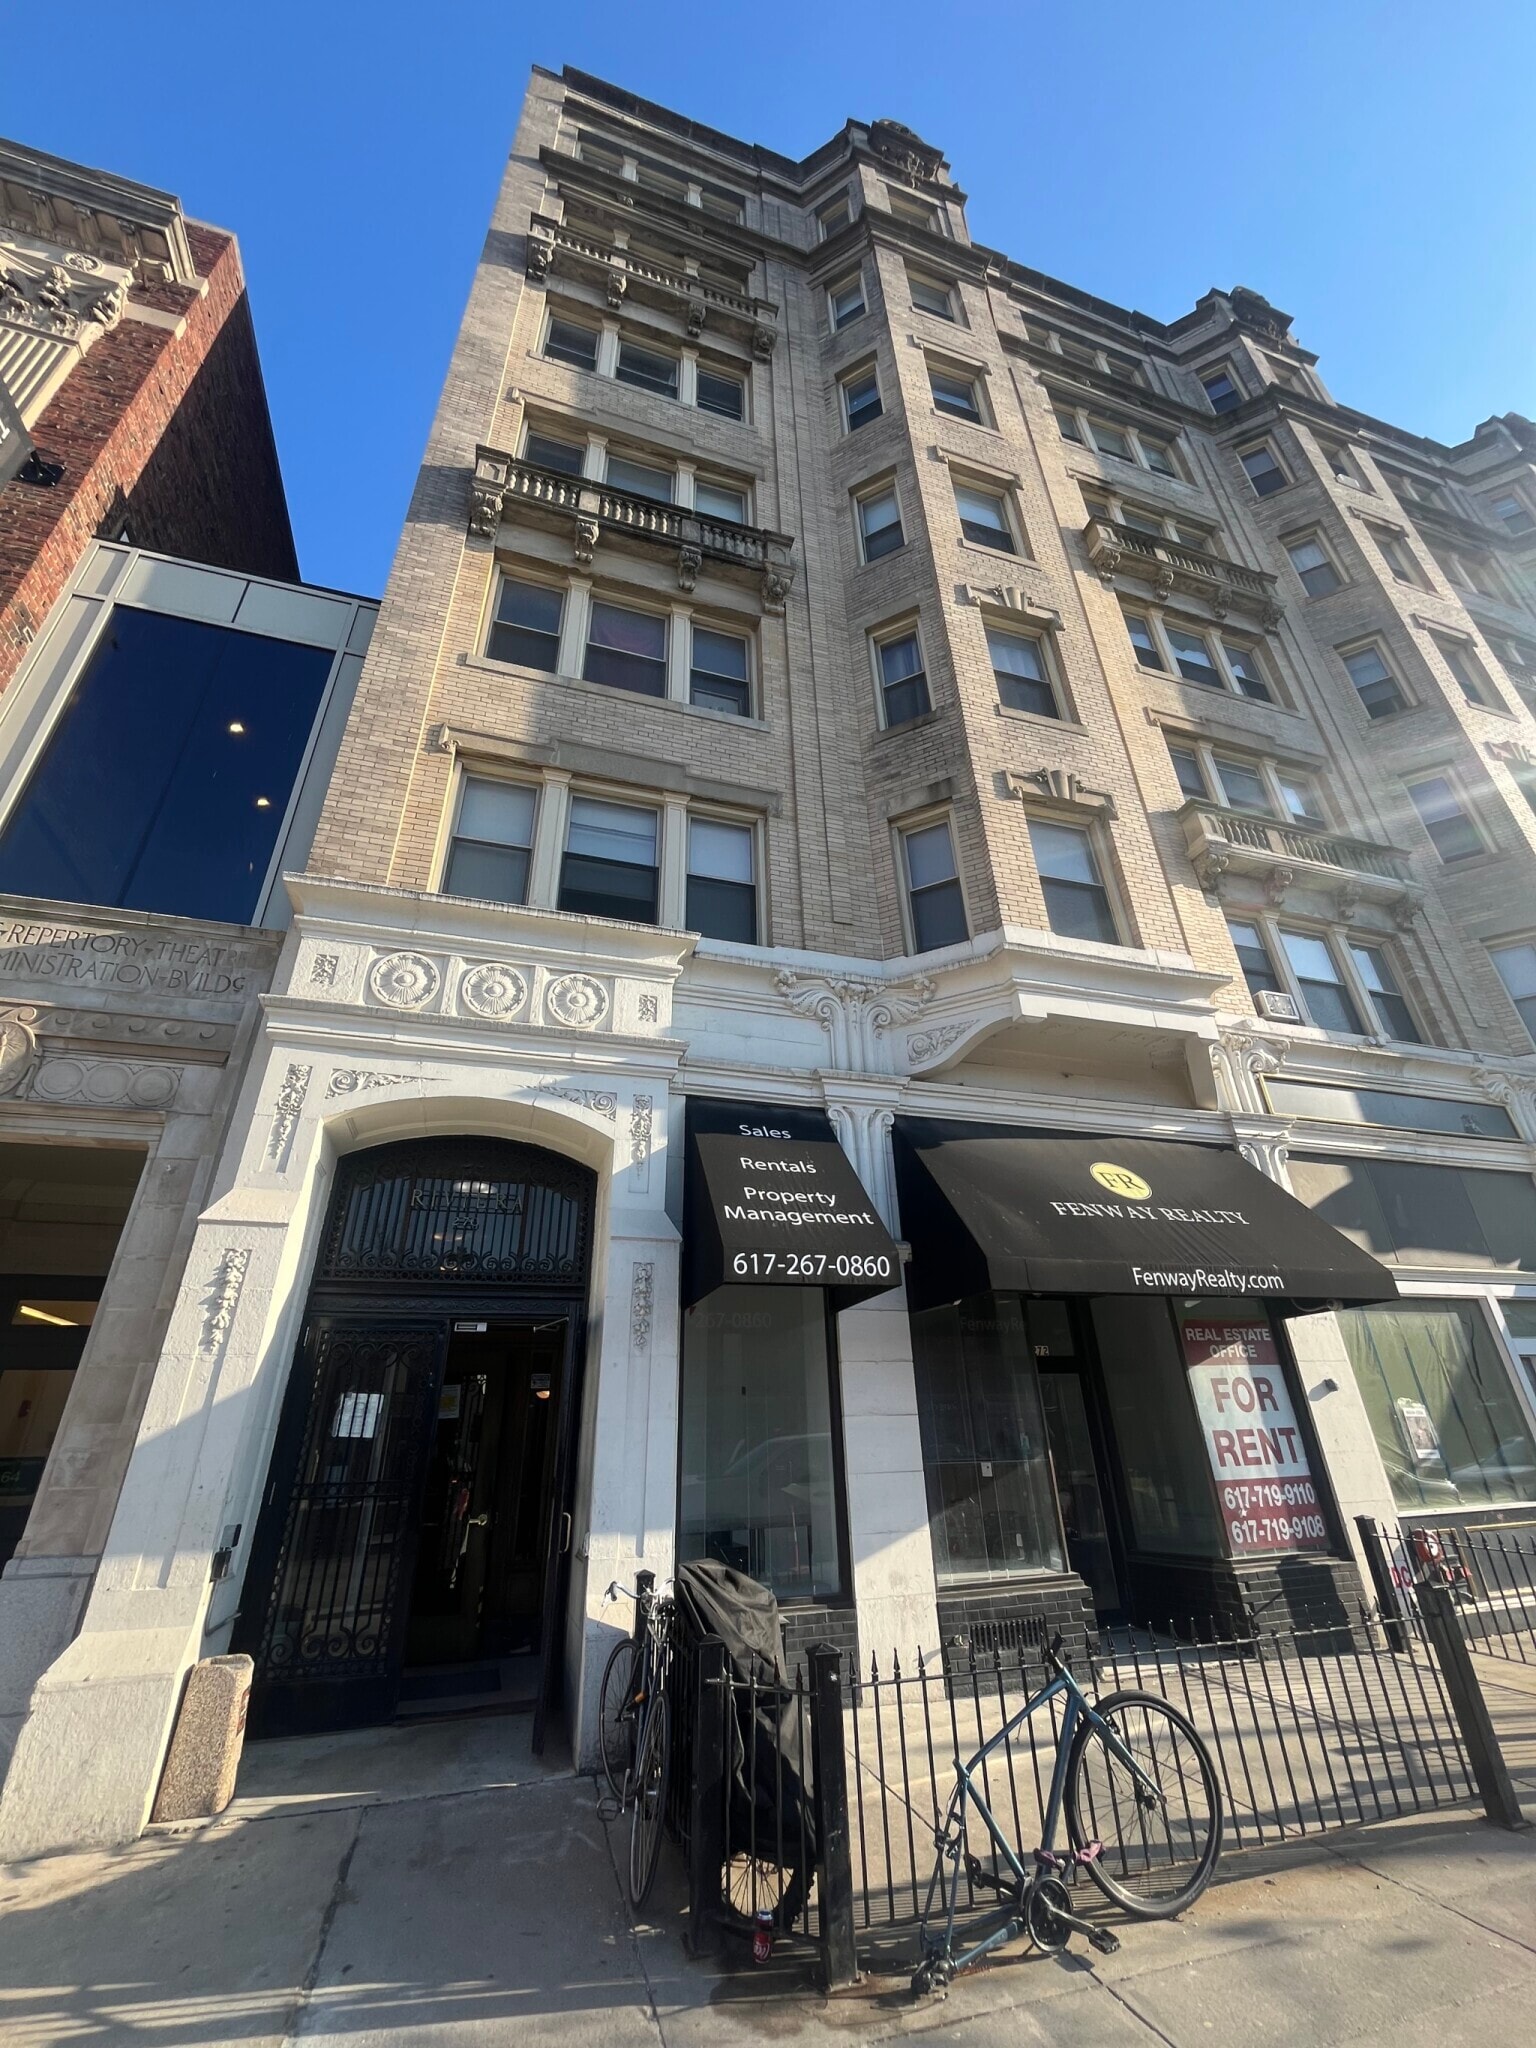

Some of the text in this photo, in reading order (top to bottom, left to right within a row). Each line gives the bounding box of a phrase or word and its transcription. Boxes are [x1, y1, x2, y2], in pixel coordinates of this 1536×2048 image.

[6, 923, 147, 958] REPERTORY
[738, 1124, 792, 1140] Sales
[739, 1156, 817, 1174] Rentals
[1099, 1171, 1145, 1190] FR
[410, 1188, 523, 1213] RIVIERA
[743, 1186, 836, 1206] Property
[723, 1204, 875, 1226] Management
[1050, 1201, 1250, 1225] FENWAY REALTY
[732, 1252, 891, 1278] 617-267-0860
[1132, 1267, 1285, 1293] FenwayRealty.com
[1185, 1327, 1272, 1342] REAL ESTATE
[1209, 1344, 1258, 1359] OFFICE
[1210, 1376, 1280, 1414] FOR
[1212, 1427, 1299, 1468] RENT
[1224, 1482, 1315, 1510] 617-719-9110
[1231, 1514, 1326, 1544] 617-719-9108
